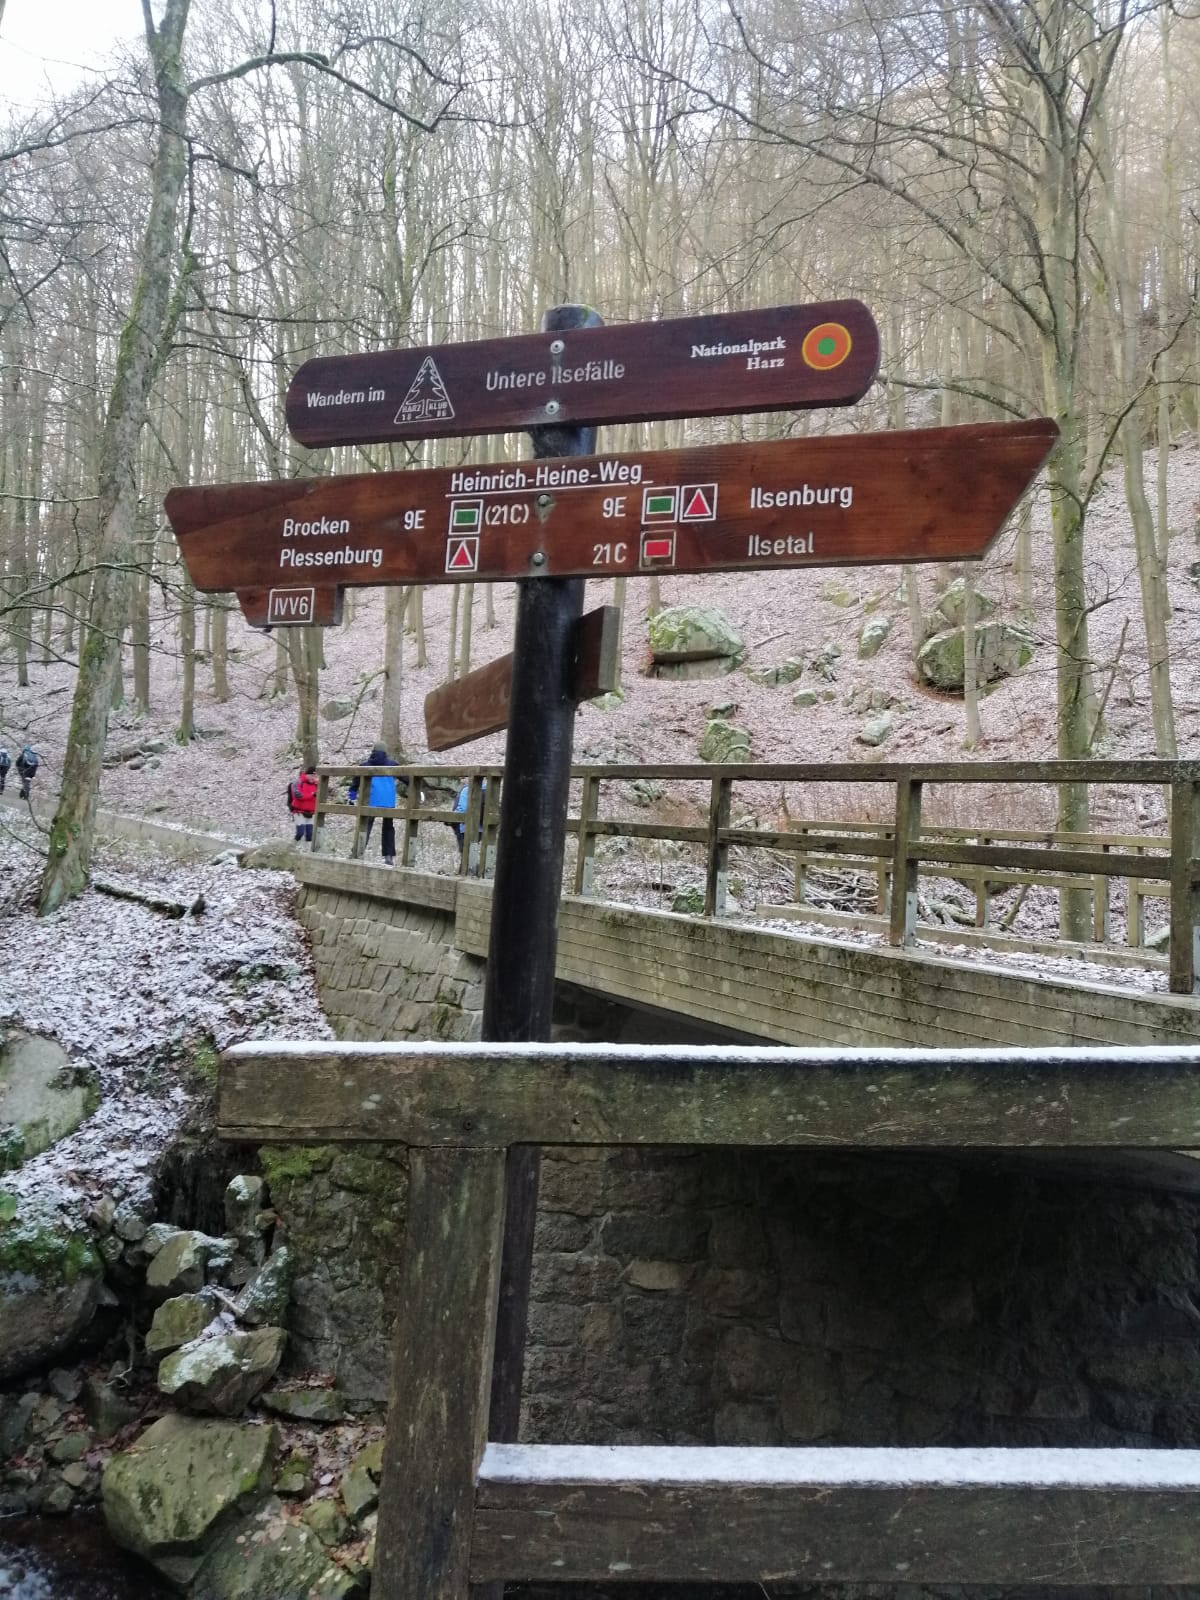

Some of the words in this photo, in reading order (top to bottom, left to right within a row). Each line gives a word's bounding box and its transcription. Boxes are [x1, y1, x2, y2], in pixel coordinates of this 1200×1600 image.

[690, 336, 786, 358] Nationalpark
[746, 357, 785, 371] Harz
[486, 368, 546, 392] Untere
[552, 358, 625, 384] Ilsefälle
[306, 390, 365, 408] Wandern
[368, 387, 385, 402] im
[451, 461, 643, 492] Heinrich-Heine-Weg
[602, 496, 627, 518] 9E
[750, 484, 853, 509] Ilsenburg
[404, 510, 426, 530] 9E
[485, 503, 530, 524] (21C)
[282, 516, 350, 537] Brocken
[593, 543, 627, 564] 21C
[747, 532, 814, 556] Ilsetal
[279, 547, 383, 568] Plessenburg
[274, 596, 309, 616] IVV6
